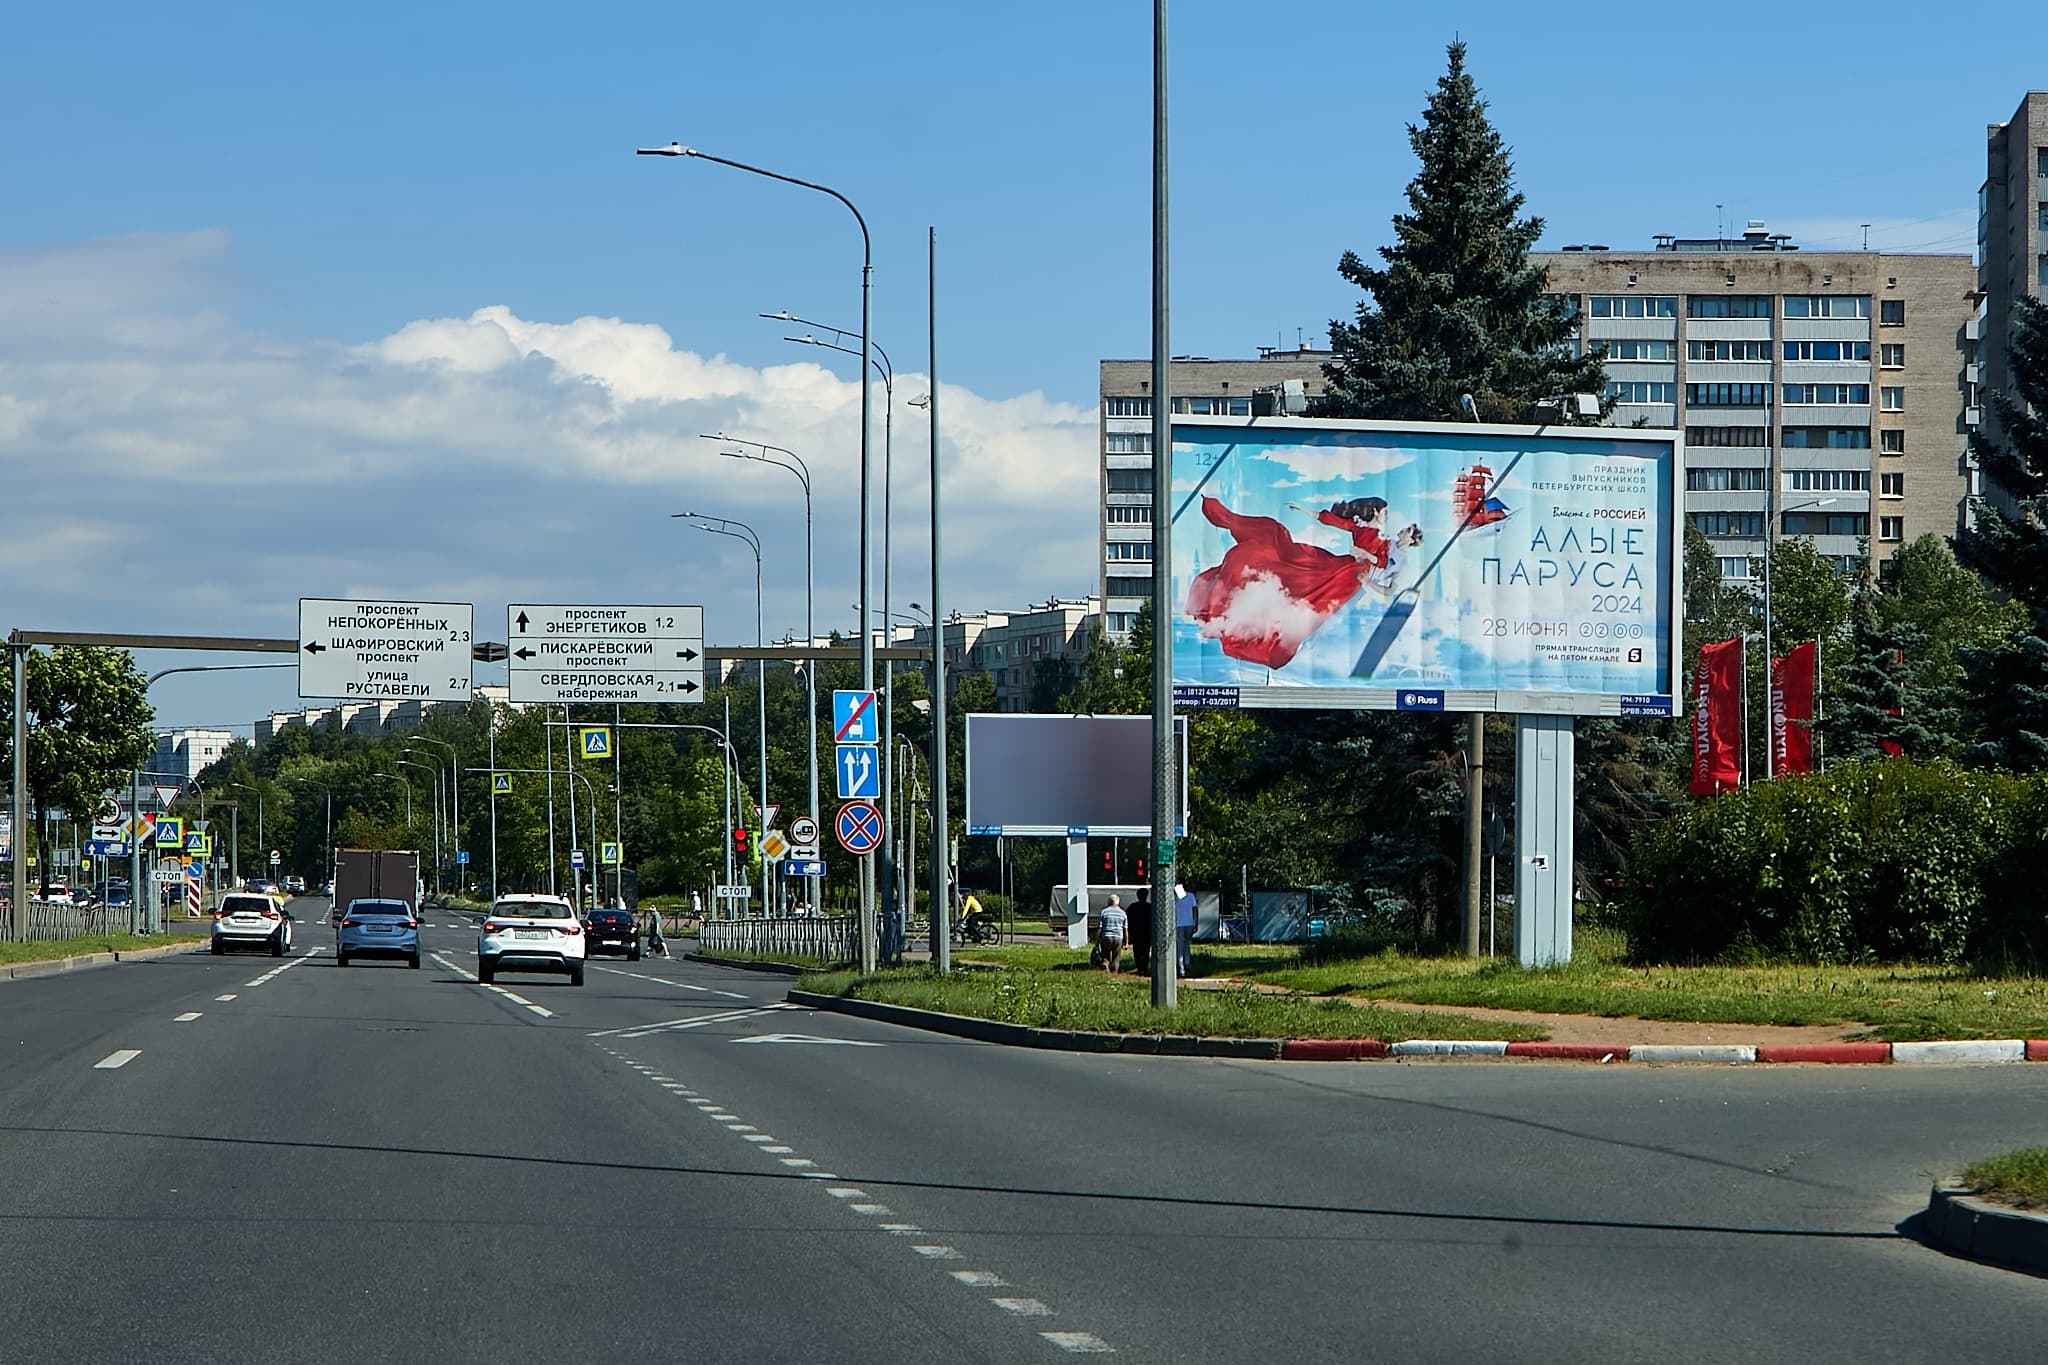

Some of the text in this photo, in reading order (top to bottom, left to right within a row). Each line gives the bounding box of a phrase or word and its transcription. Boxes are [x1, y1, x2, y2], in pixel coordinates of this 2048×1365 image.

[1595, 466, 1646, 474] ПРАЗДНИК
[1572, 474, 1646, 483] ВЫПУСКНИКОВ
[1532, 482, 1646, 493] ПЕТЕРБУРГСКИХ ШКОЛ
[1594, 508, 1645, 519] РОССИЕЙ
[1531, 526, 1644, 554] АЛЫЕ
[1482, 558, 1643, 589] ПАРУСА
[1592, 595, 1642, 613] 2024
[357, 606, 419, 616] проспект
[566, 610, 626, 620] проспект
[328, 617, 448, 630] НЕПОКОРЁННЫХ
[546, 622, 646, 633] ЭНЕРГЕТИКОВ
[1482, 619, 1507, 636] 28
[1514, 622, 1568, 636] ИЮНЯ
[332, 638, 444, 651] ШАФИРОВСКИЙ
[541, 641, 652, 653] ПИСКАРЁВСКИЙ
[1536, 644, 1567, 652] ПРЯМАЯ
[357, 653, 419, 664] проспект
[567, 656, 627, 667] проспект
[367, 672, 408, 682] улица
[541, 674, 653, 686] СВЕРДЛОВСКАЯ
[347, 683, 429, 695] РУСТАВЕЛИ
[558, 688, 638, 699] набережная
[1417, 695, 1438, 705] Russ
[155, 871, 181, 881] СТОП
